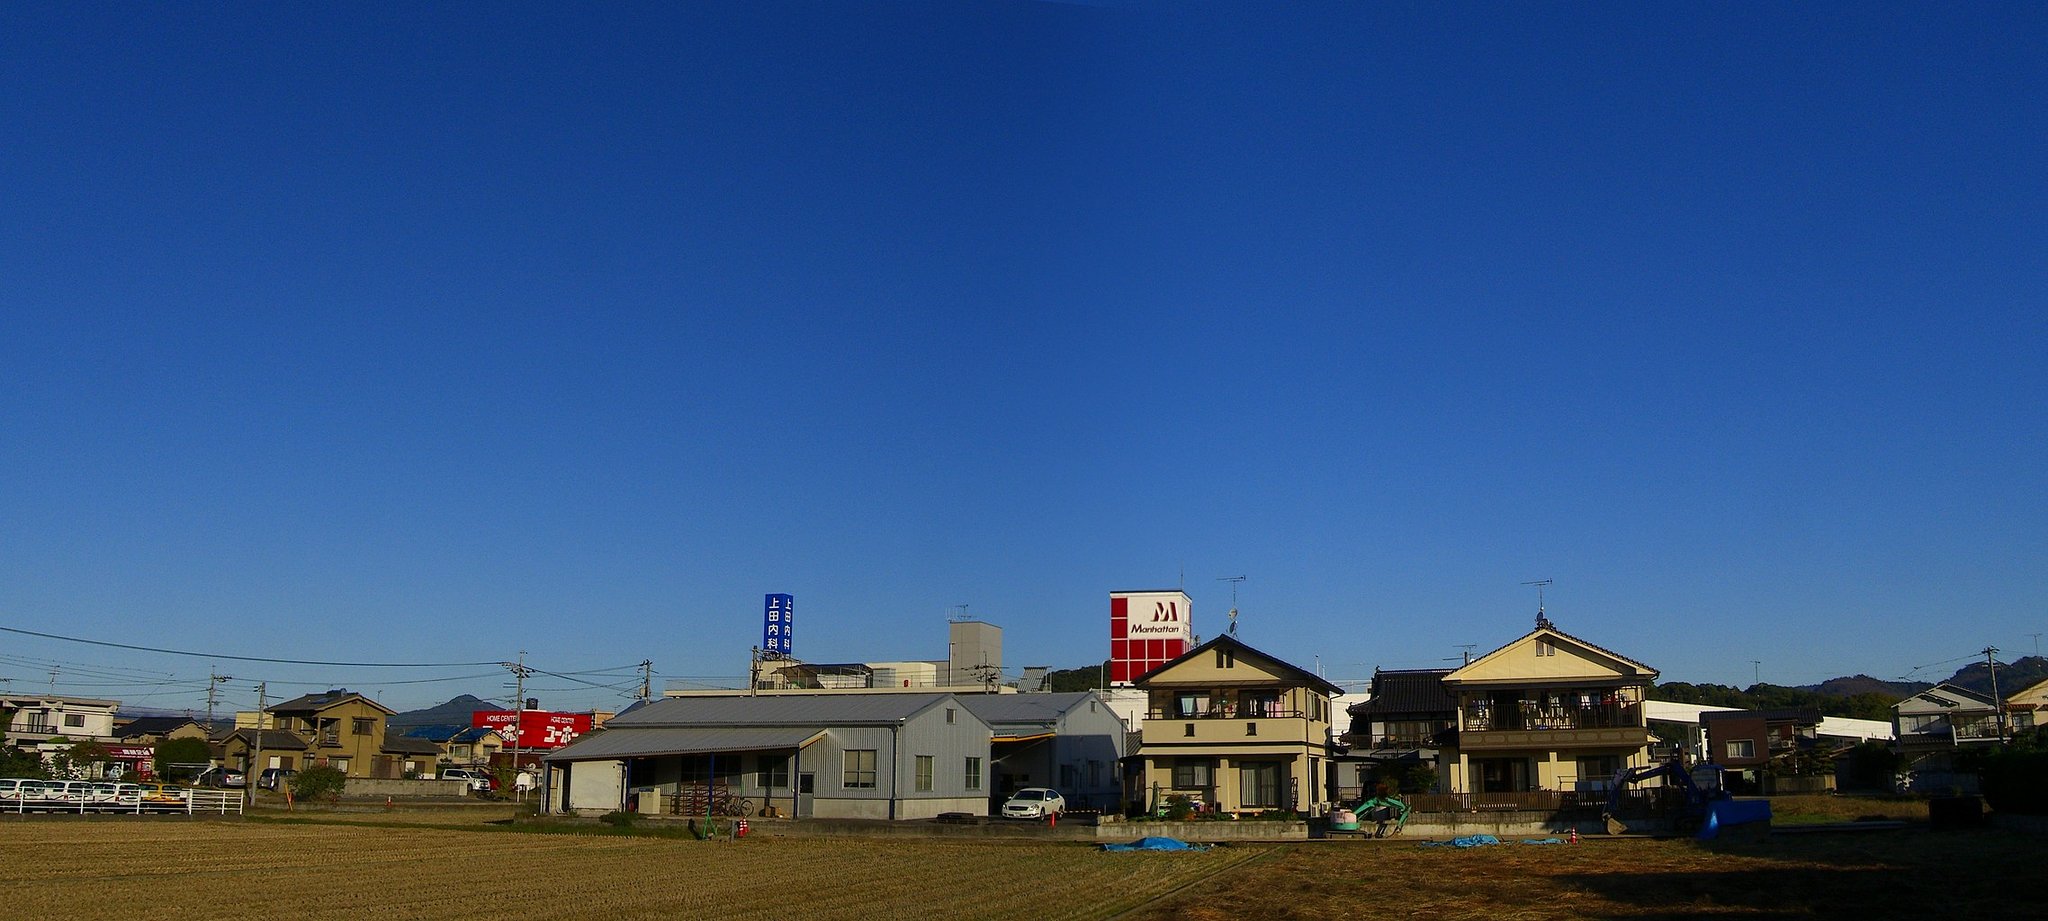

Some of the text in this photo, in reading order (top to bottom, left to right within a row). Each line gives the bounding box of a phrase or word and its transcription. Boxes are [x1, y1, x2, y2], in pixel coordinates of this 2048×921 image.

[768, 597, 779, 649] 上田内科
[1131, 624, 1179, 633] Manhattan
